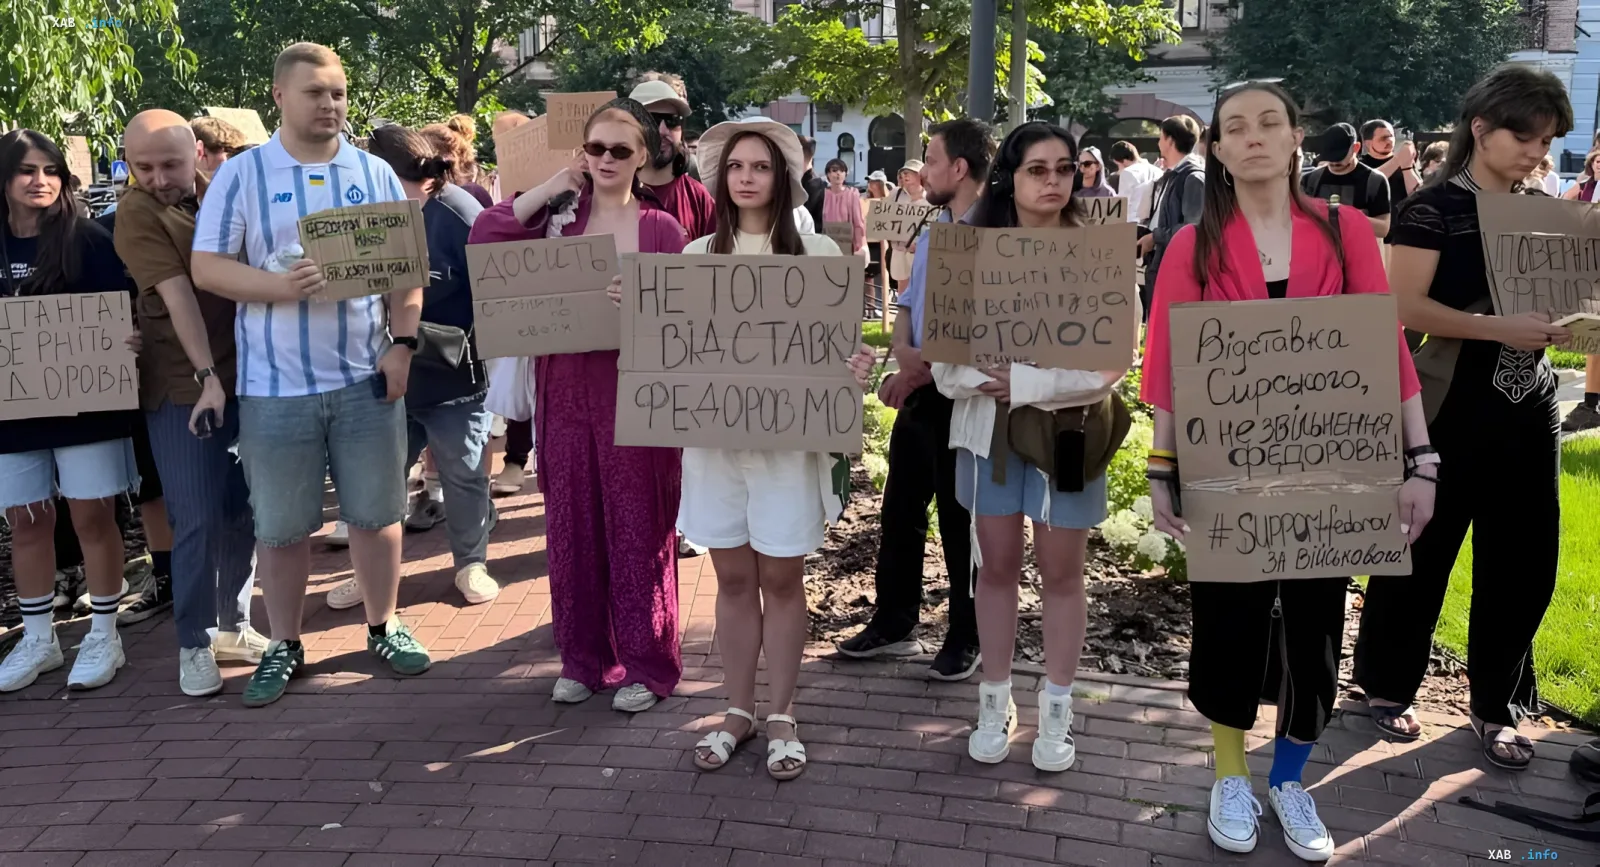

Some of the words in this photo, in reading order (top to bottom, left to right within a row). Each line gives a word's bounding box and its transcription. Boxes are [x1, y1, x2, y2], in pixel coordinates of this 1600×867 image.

[996, 234, 1080, 258] СТРАХ
[477, 242, 607, 287] ДОСИТЬ
[638, 263, 685, 316] НЕ
[696, 263, 805, 316] ТОГО
[823, 264, 850, 307] У
[933, 292, 976, 315] НАМ
[928, 319, 988, 344] ЯКЩО
[995, 316, 1113, 352] ГОЛОС
[1197, 316, 1349, 375] Відставка
[1186, 417, 1207, 445] а
[1262, 551, 1286, 573] ЗА
